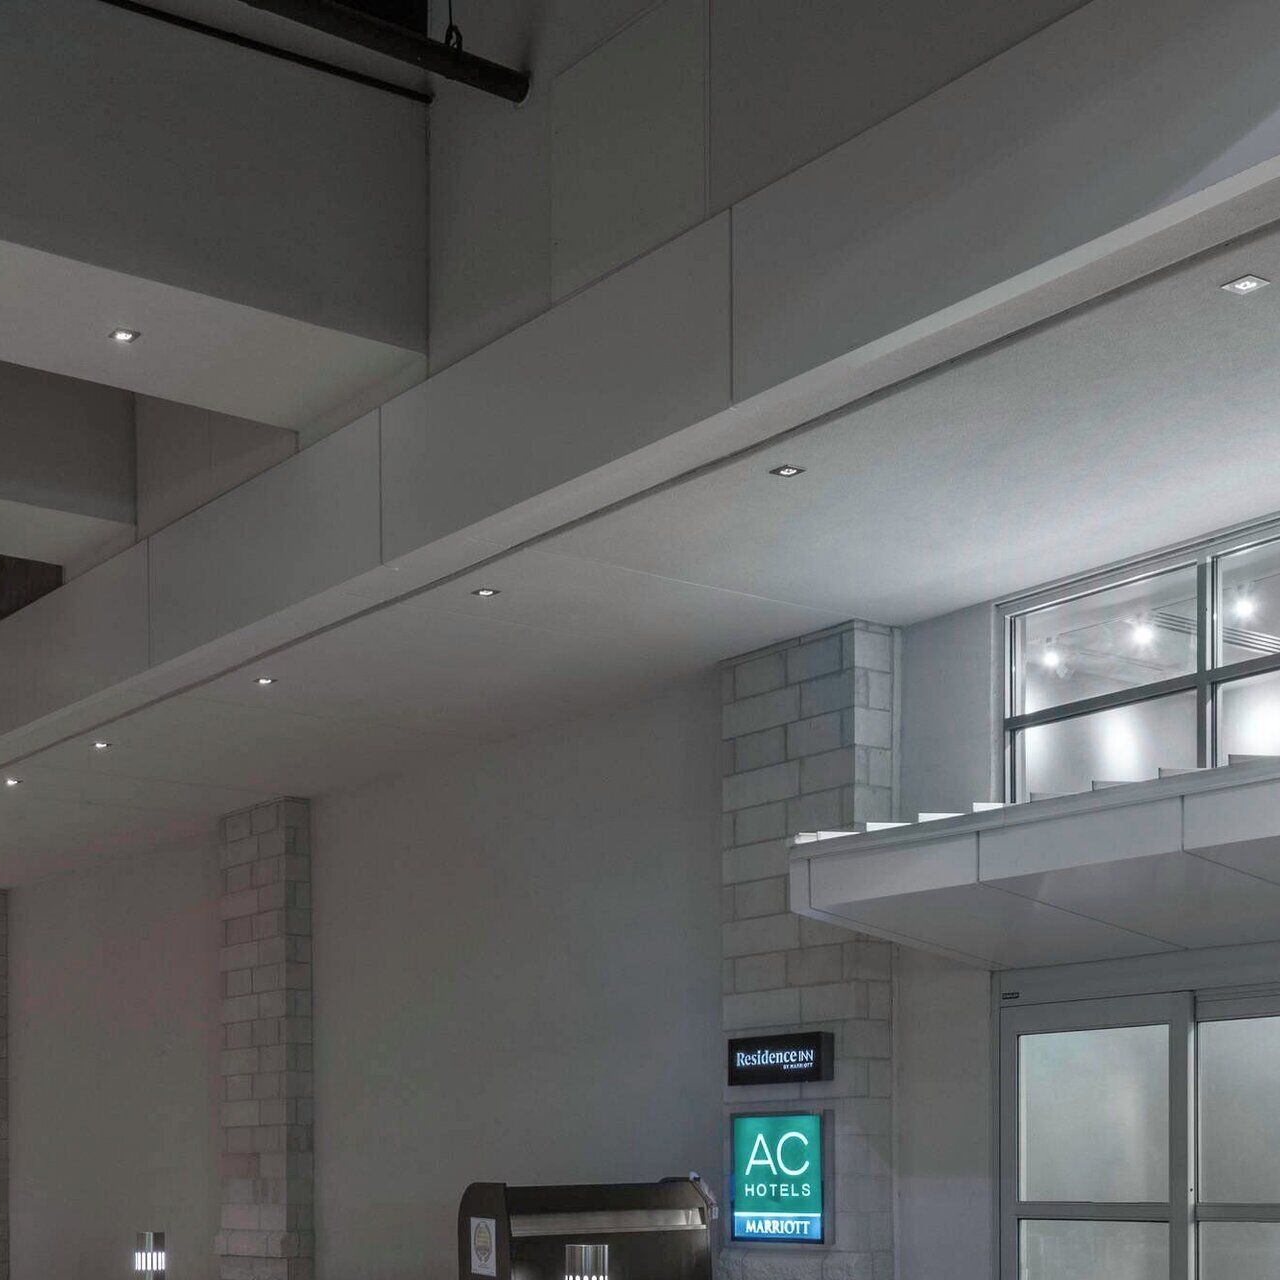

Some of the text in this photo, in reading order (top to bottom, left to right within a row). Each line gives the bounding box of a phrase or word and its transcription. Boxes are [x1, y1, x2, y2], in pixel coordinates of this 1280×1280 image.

[736, 1049, 814, 1067] Residence INN
[745, 1131, 810, 1176] AC
[744, 1183, 811, 1197] HOTELS
[744, 1219, 811, 1235] MARRIOTT
